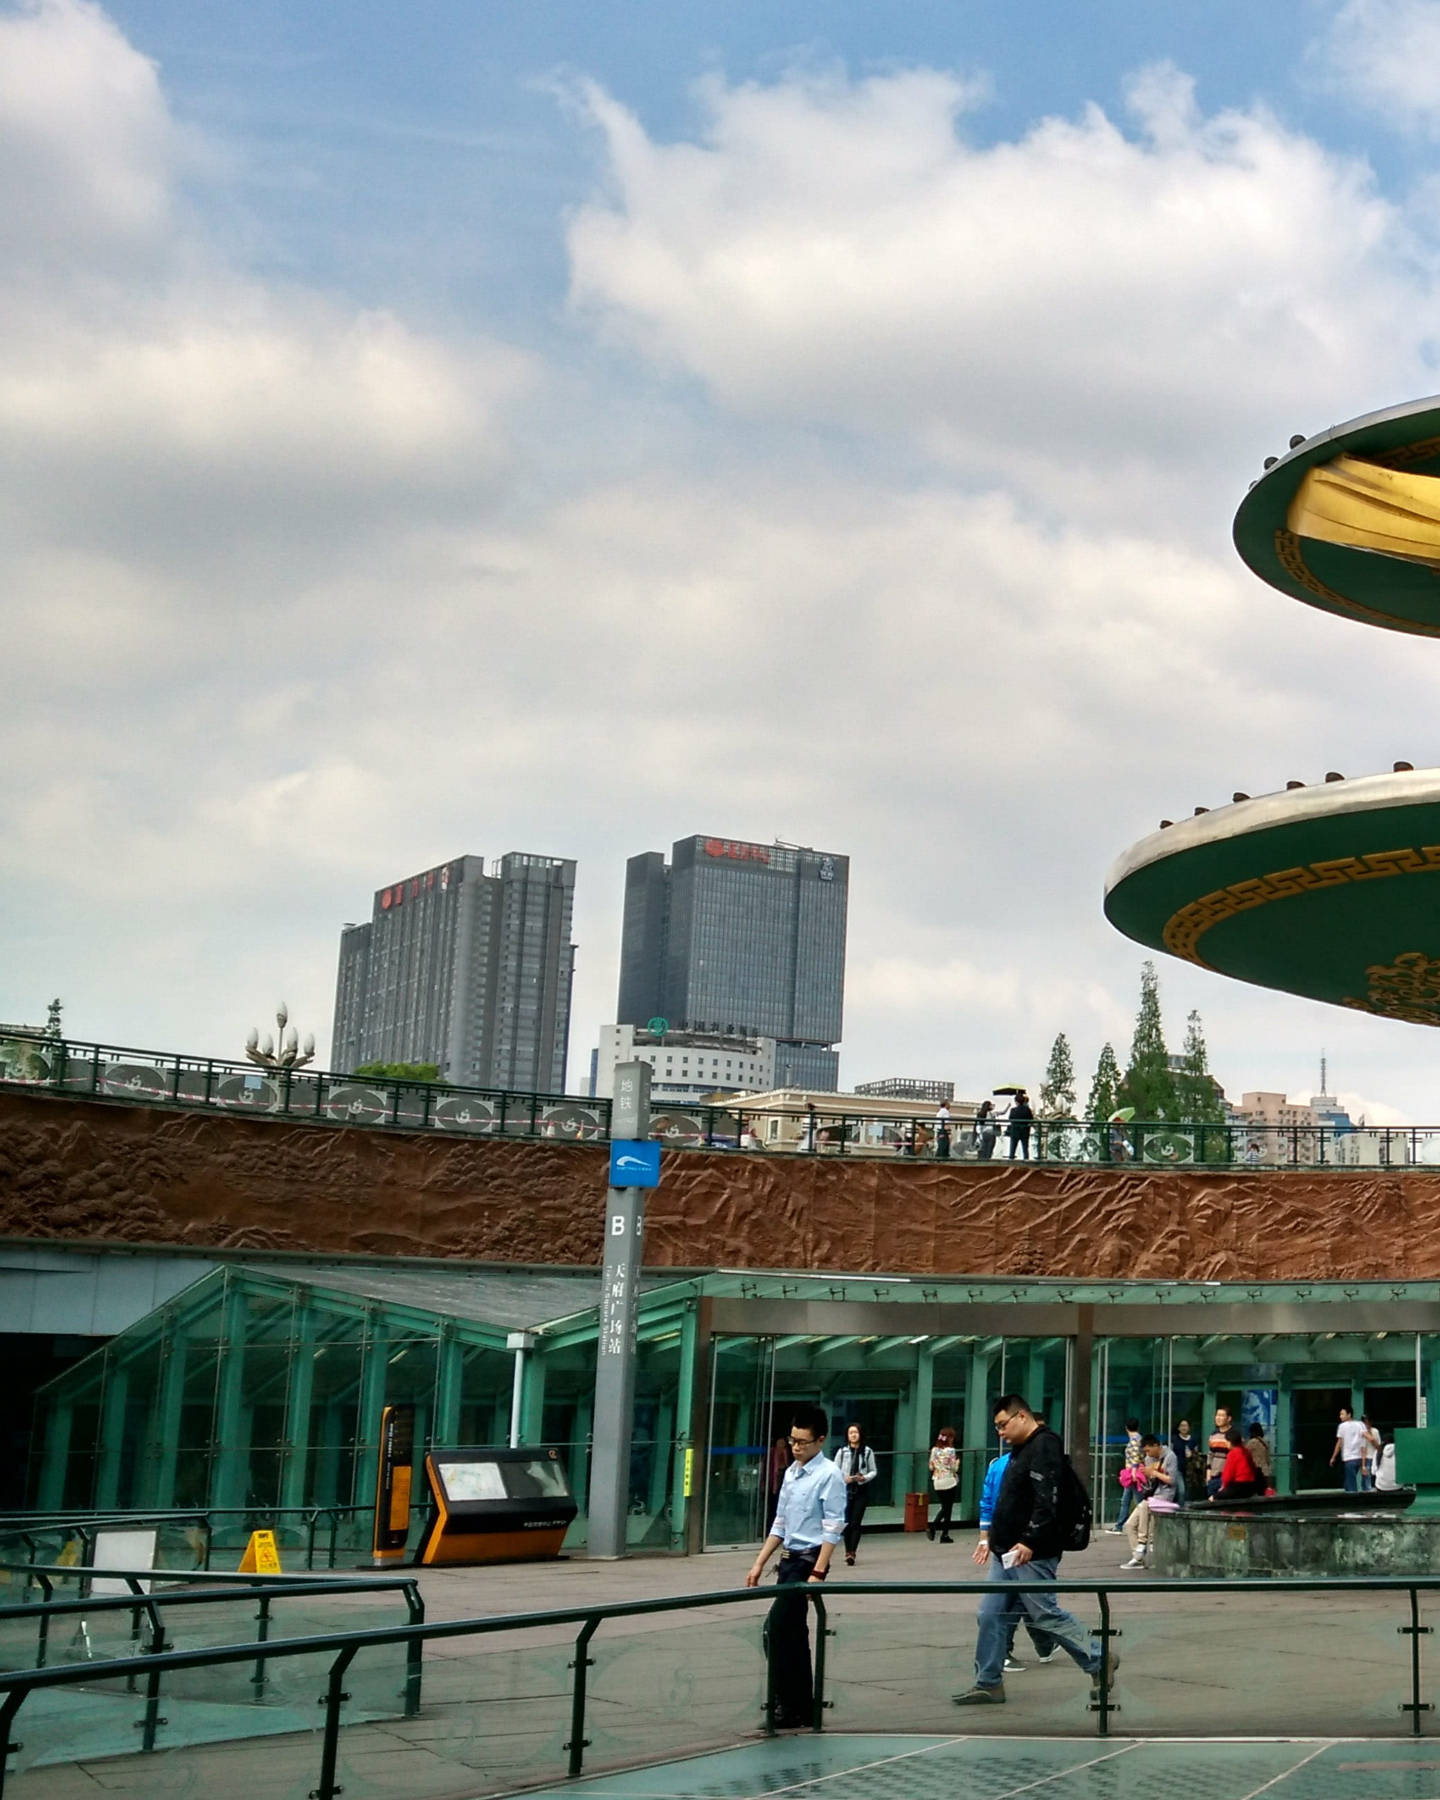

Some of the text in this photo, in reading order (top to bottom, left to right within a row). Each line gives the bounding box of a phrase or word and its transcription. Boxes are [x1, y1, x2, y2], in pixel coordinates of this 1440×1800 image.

[620, 1079, 633, 1110] 地铁
[611, 1215, 625, 1236] B
[608, 1263, 625, 1355] 天府广场站
